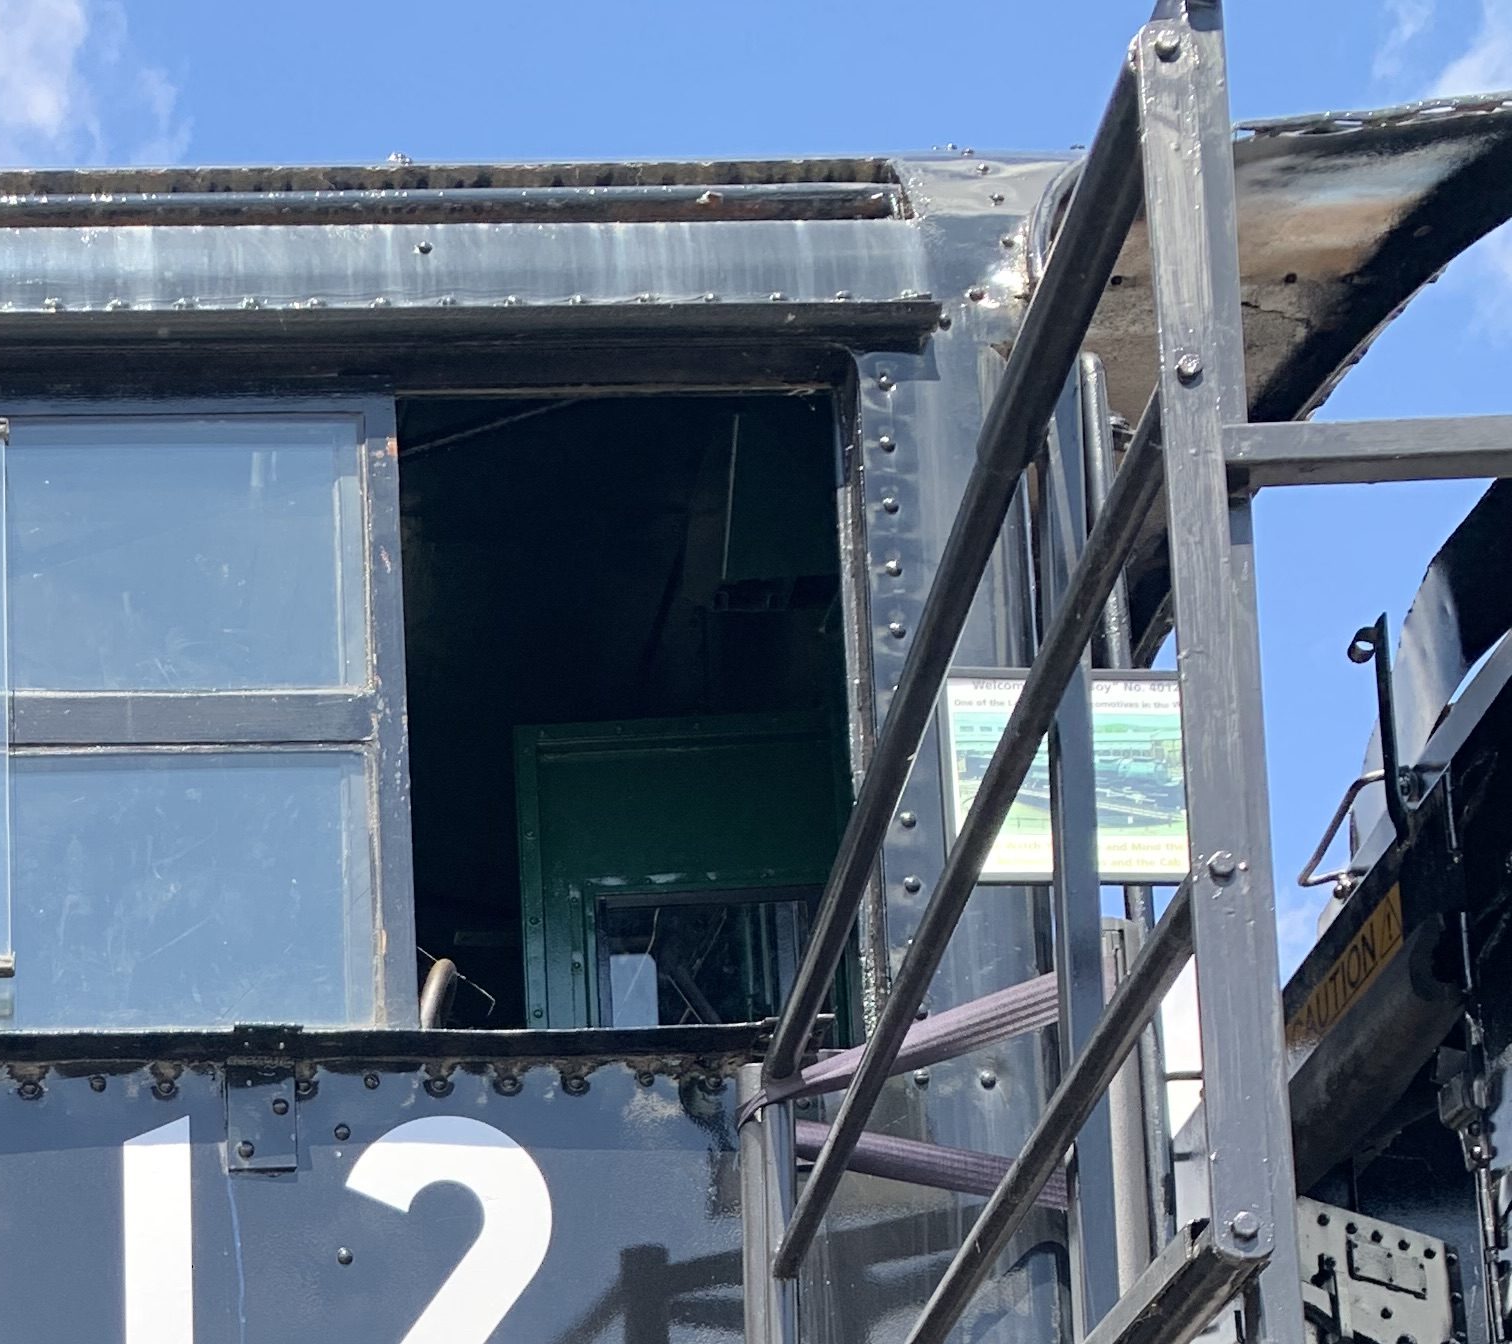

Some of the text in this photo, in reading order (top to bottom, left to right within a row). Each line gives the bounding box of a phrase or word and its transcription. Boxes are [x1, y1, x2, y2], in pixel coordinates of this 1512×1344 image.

[973, 681, 1024, 690] Welcom
[1091, 682, 1118, 694] oy"
[1124, 683, 1144, 692] No.
